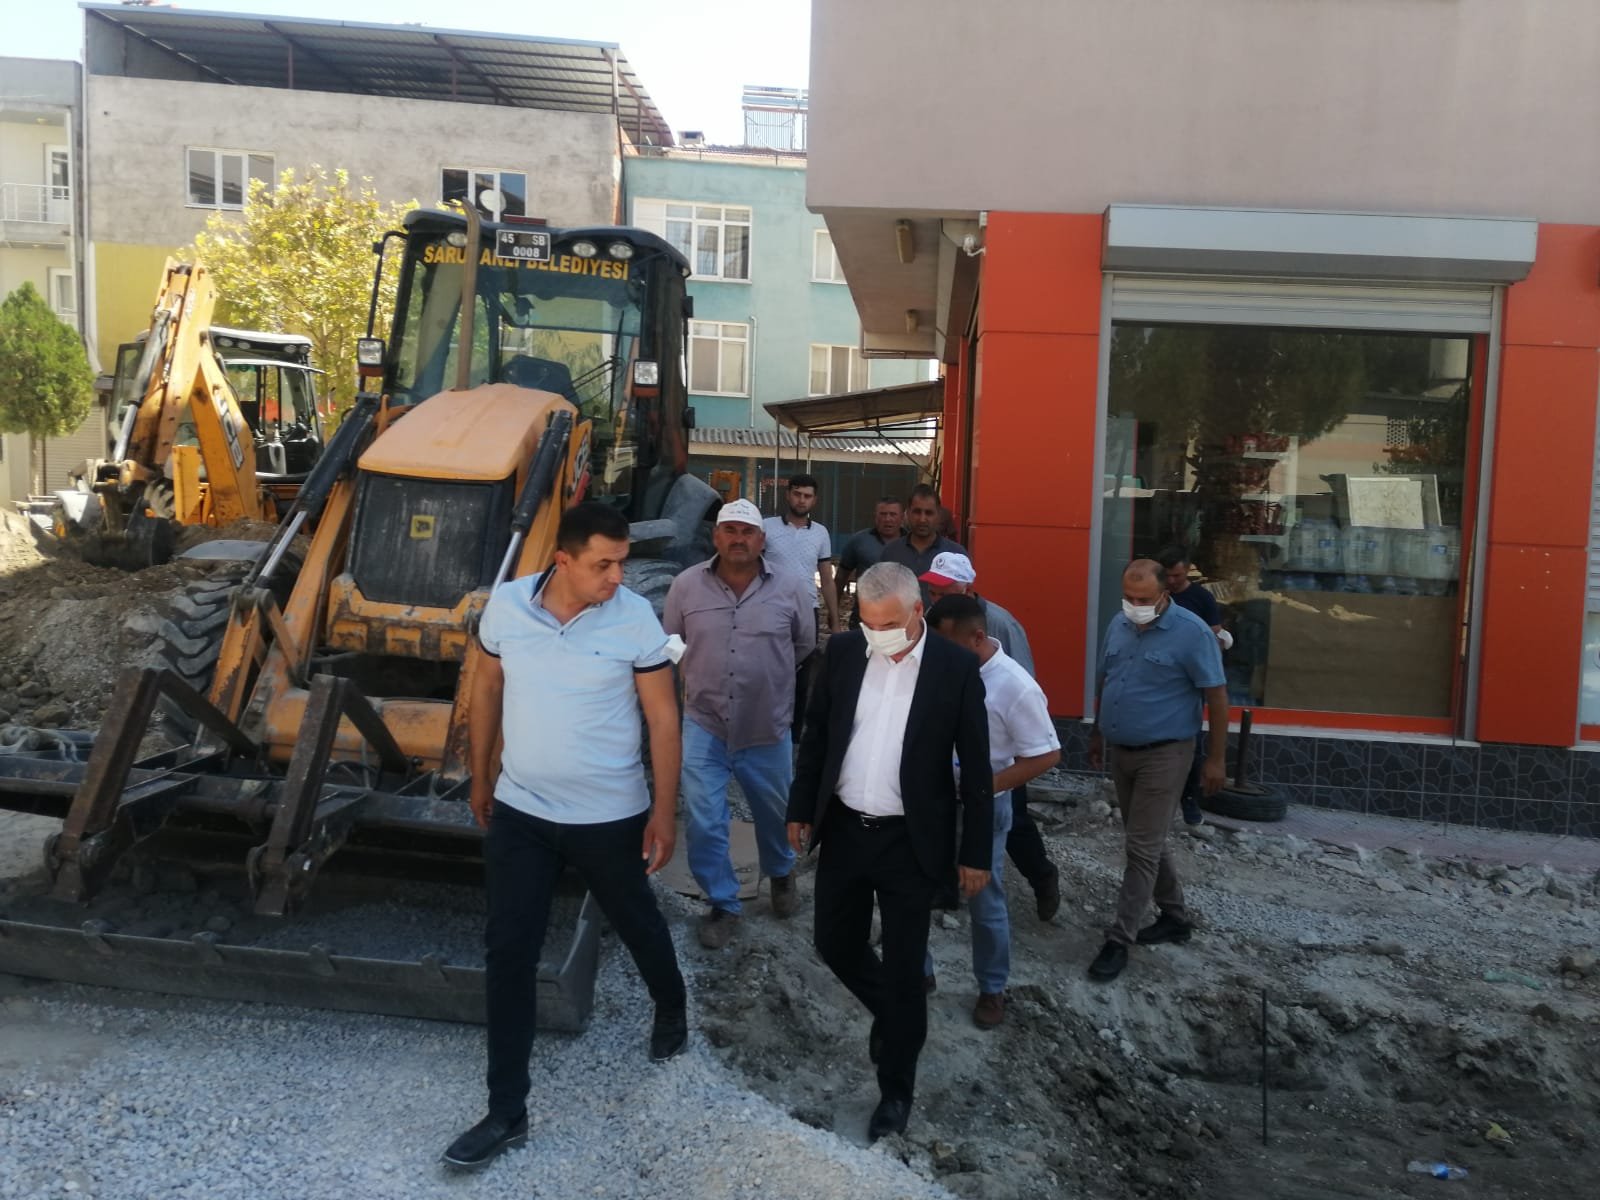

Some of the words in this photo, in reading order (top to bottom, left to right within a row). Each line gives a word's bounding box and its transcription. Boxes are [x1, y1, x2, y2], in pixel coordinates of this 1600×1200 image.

[500, 232, 515, 244] 45
[532, 234, 546, 246] SB
[423, 245, 520, 268] SARUANLI
[512, 246, 540, 258] 0008
[213, 389, 244, 469] JCB
